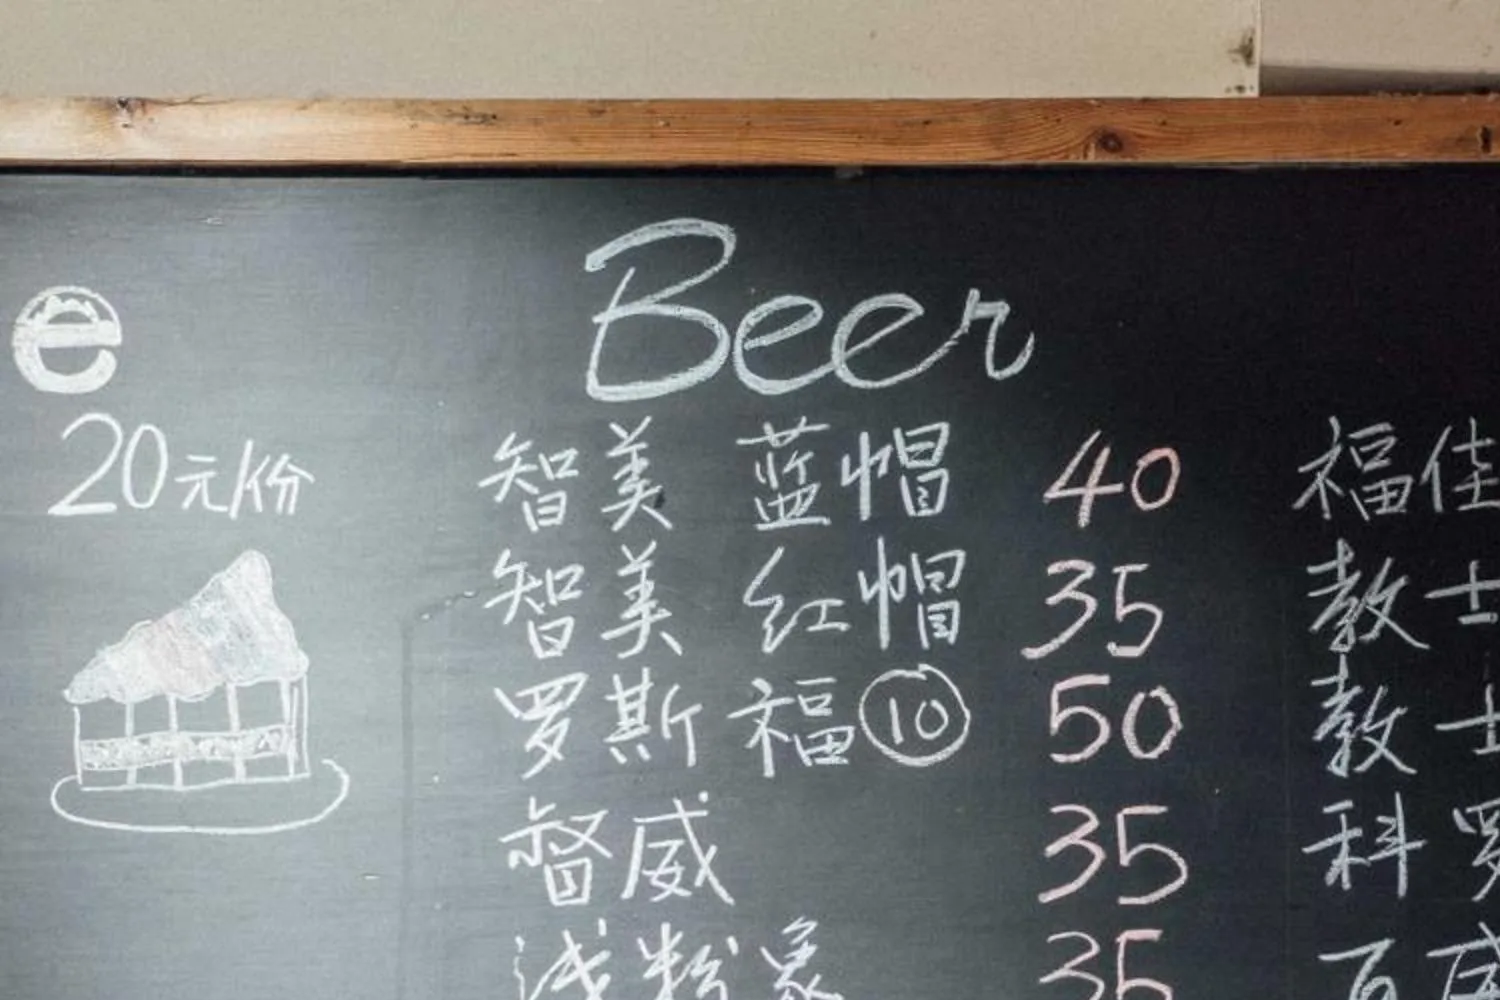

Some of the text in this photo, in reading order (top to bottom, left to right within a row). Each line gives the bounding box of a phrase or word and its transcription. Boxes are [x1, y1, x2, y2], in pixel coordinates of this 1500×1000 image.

[584, 218, 1035, 402] Beer
[1043, 430, 1180, 528] 40
[1021, 559, 1163, 659] 35
[1050, 674, 1183, 763] 50
[500, 791, 1188, 906] 督威 35
